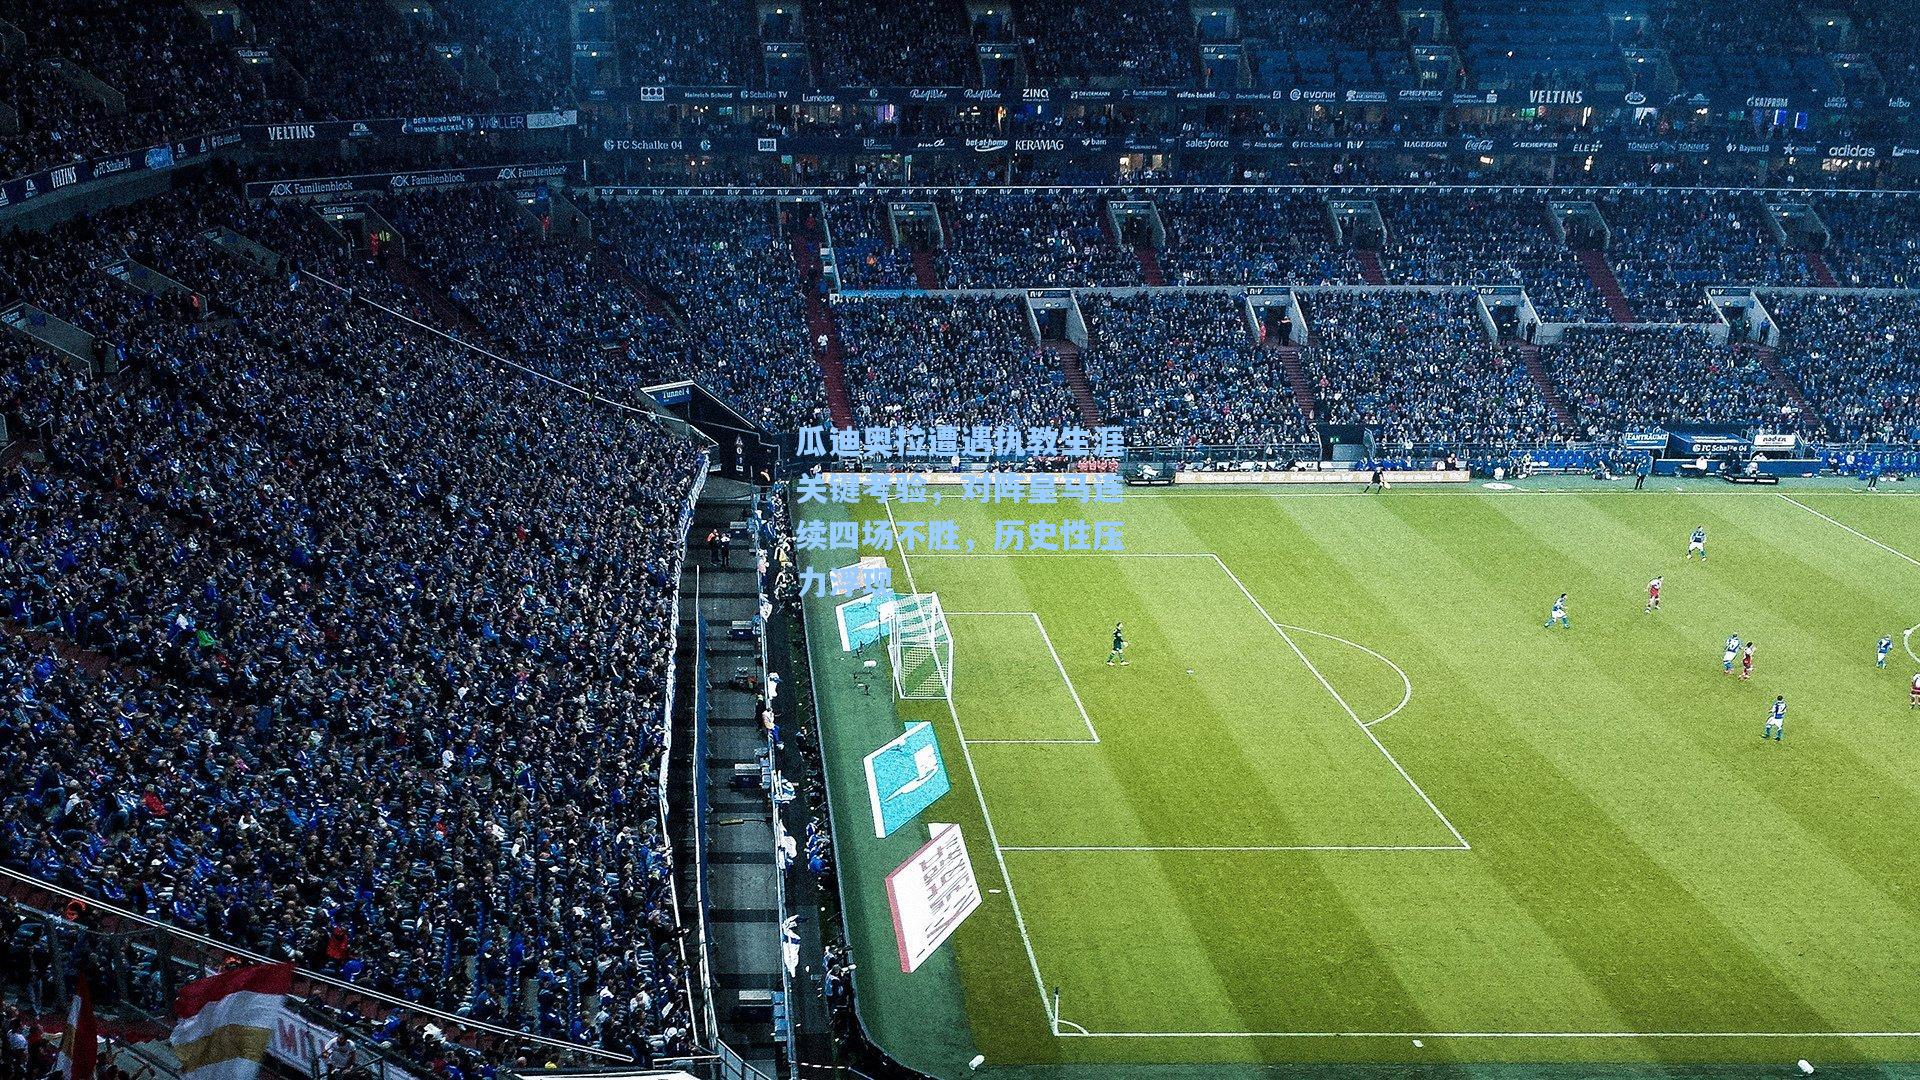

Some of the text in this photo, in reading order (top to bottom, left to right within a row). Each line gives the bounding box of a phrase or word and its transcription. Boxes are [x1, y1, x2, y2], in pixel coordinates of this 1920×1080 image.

[1022, 89, 1049, 98] ZINQ
[1530, 90, 1583, 104] VELTINS
[268, 125, 315, 140] VELTINS
[618, 141, 682, 150] FC Schalke 04
[1015, 140, 1064, 151] KERAMAG
[1186, 139, 1229, 150] salesforce
[1829, 145, 1875, 157] adidas
[497, 166, 567, 179] AOK Familienblock
[391, 172, 465, 187] AOK Familienblock
[269, 180, 353, 196] AOK Familienblock
[663, 389, 685, 399] Tunnel
